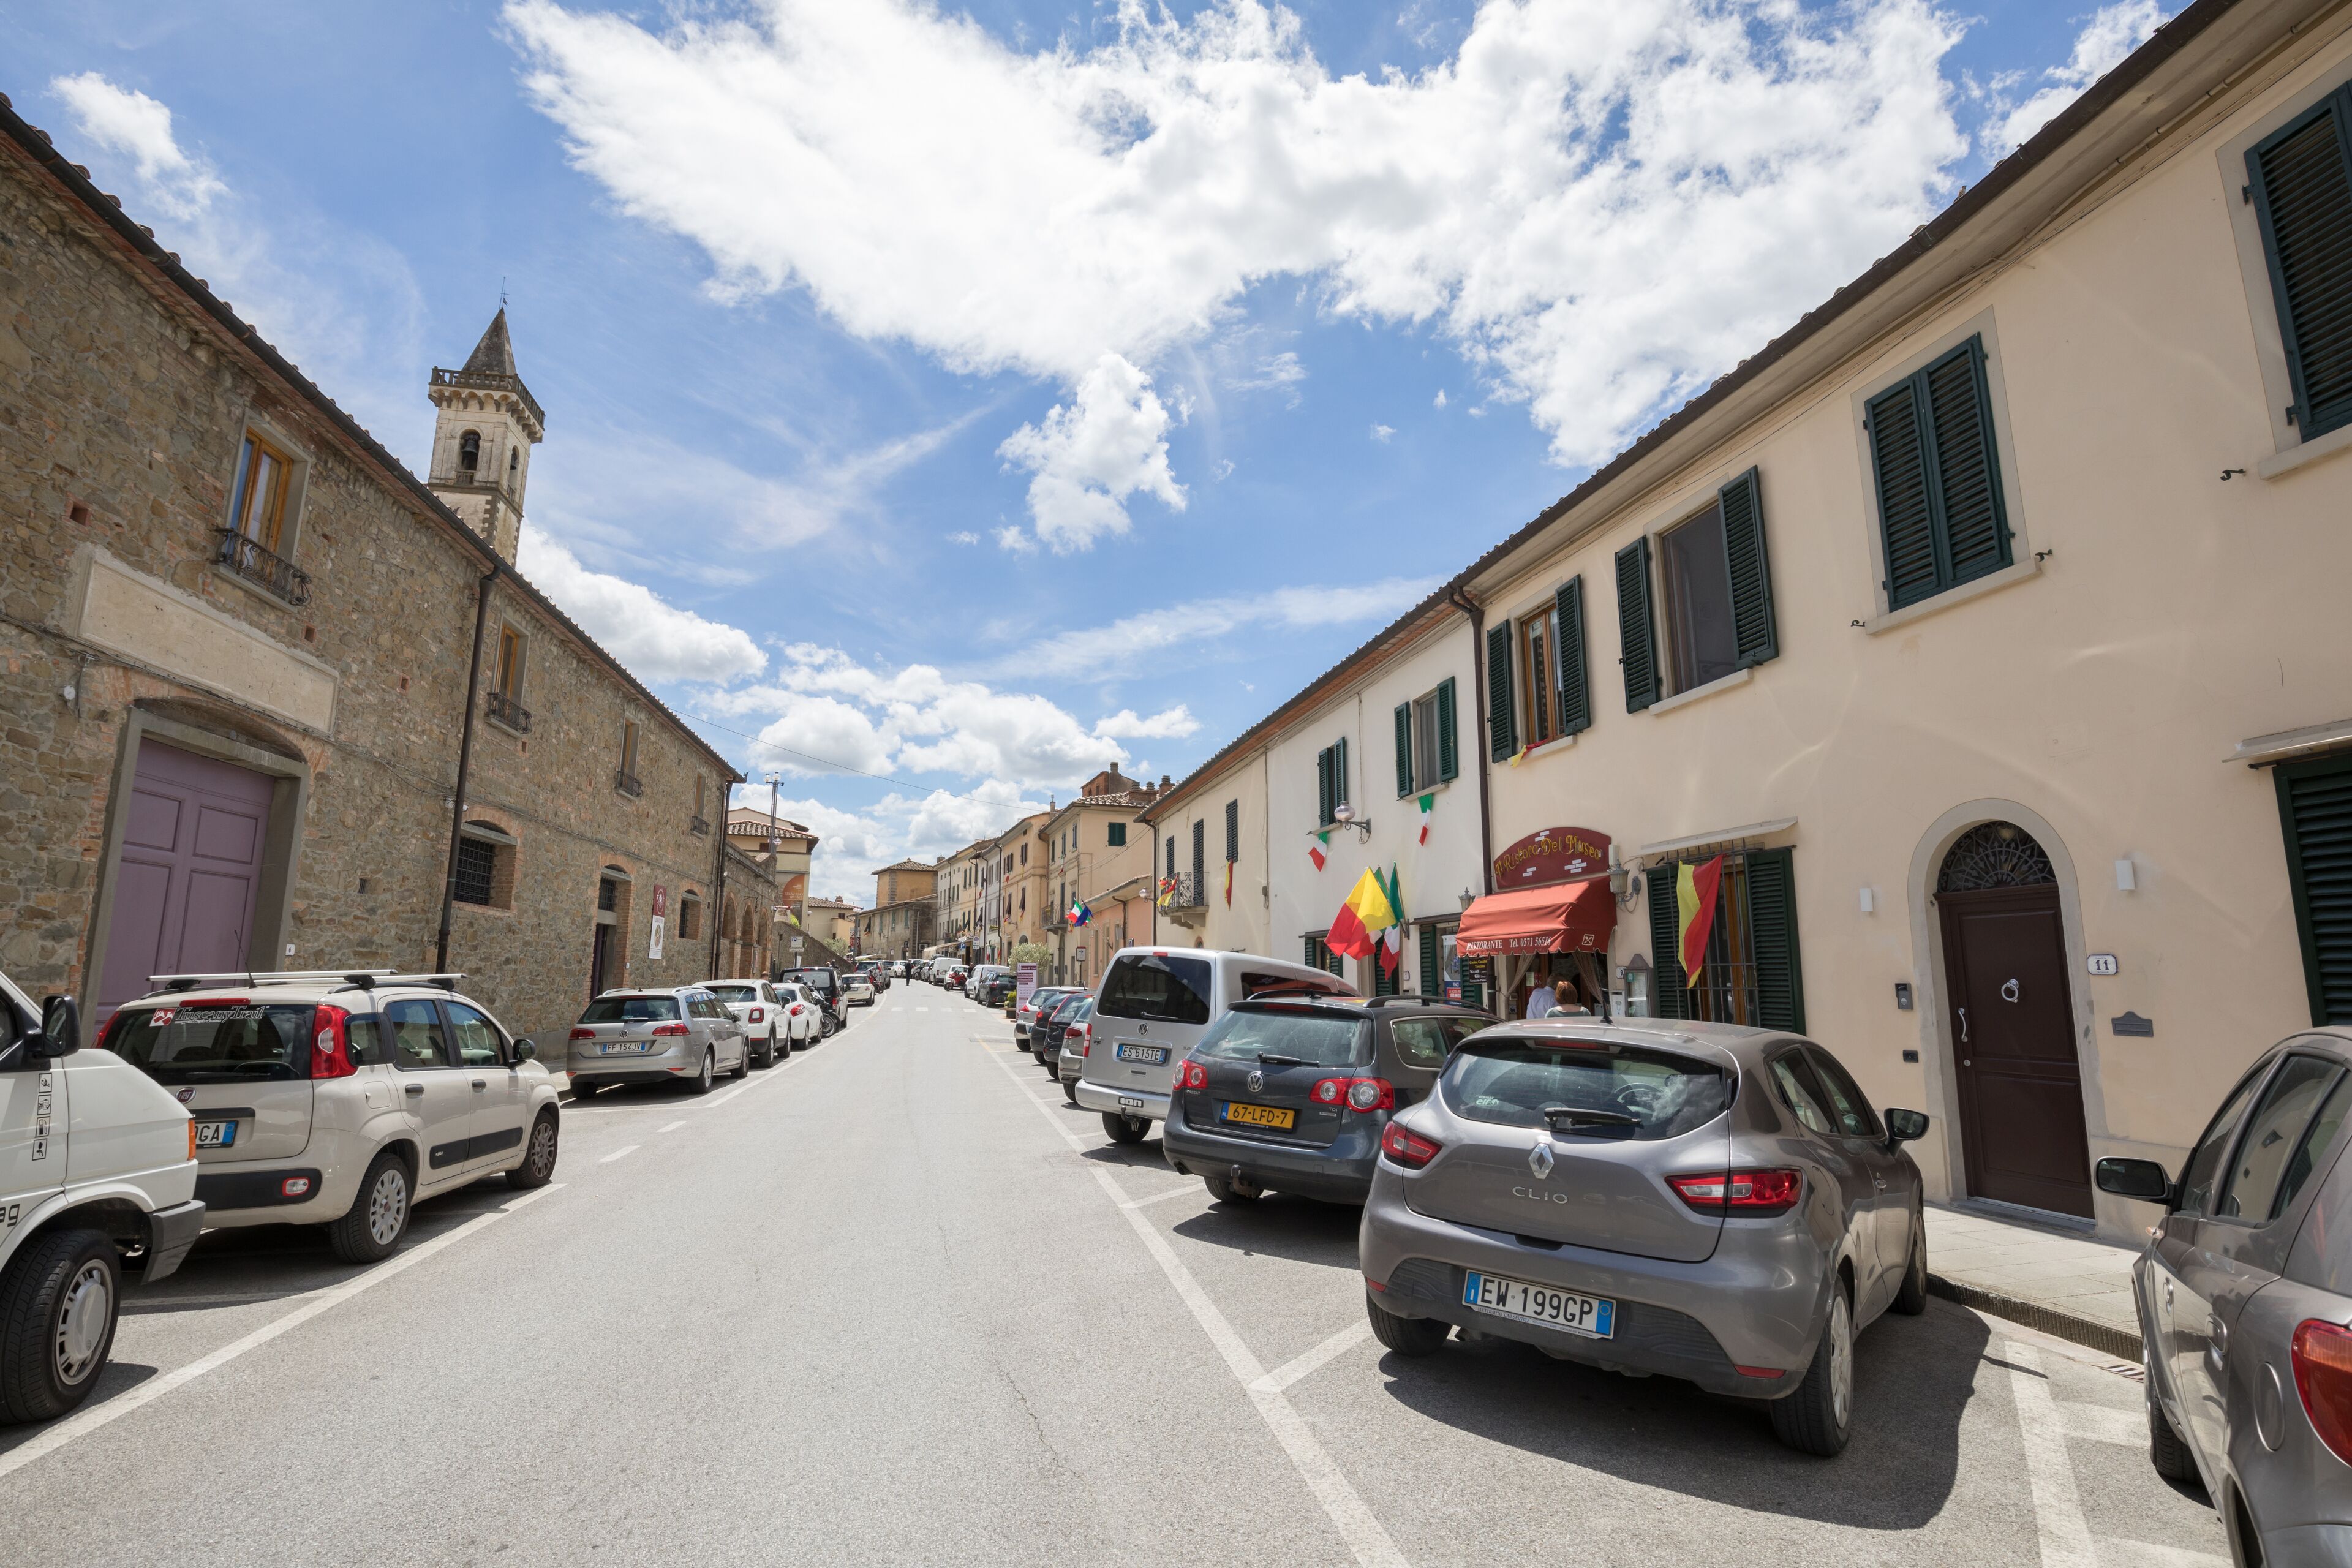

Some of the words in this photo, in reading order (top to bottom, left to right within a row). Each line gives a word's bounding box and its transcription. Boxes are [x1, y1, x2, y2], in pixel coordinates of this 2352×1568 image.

[1540, 837, 1562, 856] Del
[1563, 835, 1603, 860] Museo
[1466, 940, 1502, 950] RISTORANTE
[1509, 938, 1519, 948] Tel.
[1520, 937, 1532, 947] 0571
[2095, 959, 2109, 970] 11
[619, 1042, 641, 1051] 154JV
[1122, 1046, 1133, 1057] ES
[1135, 1047, 1161, 1060] 615TE
[178, 1091, 192, 1100] FIAT
[1232, 1106, 1288, 1125] 67-LFD-7
[1512, 1186, 1569, 1204] CLIO
[1480, 1278, 1510, 1308] EW
[1521, 1287, 1593, 1325] 199GP
